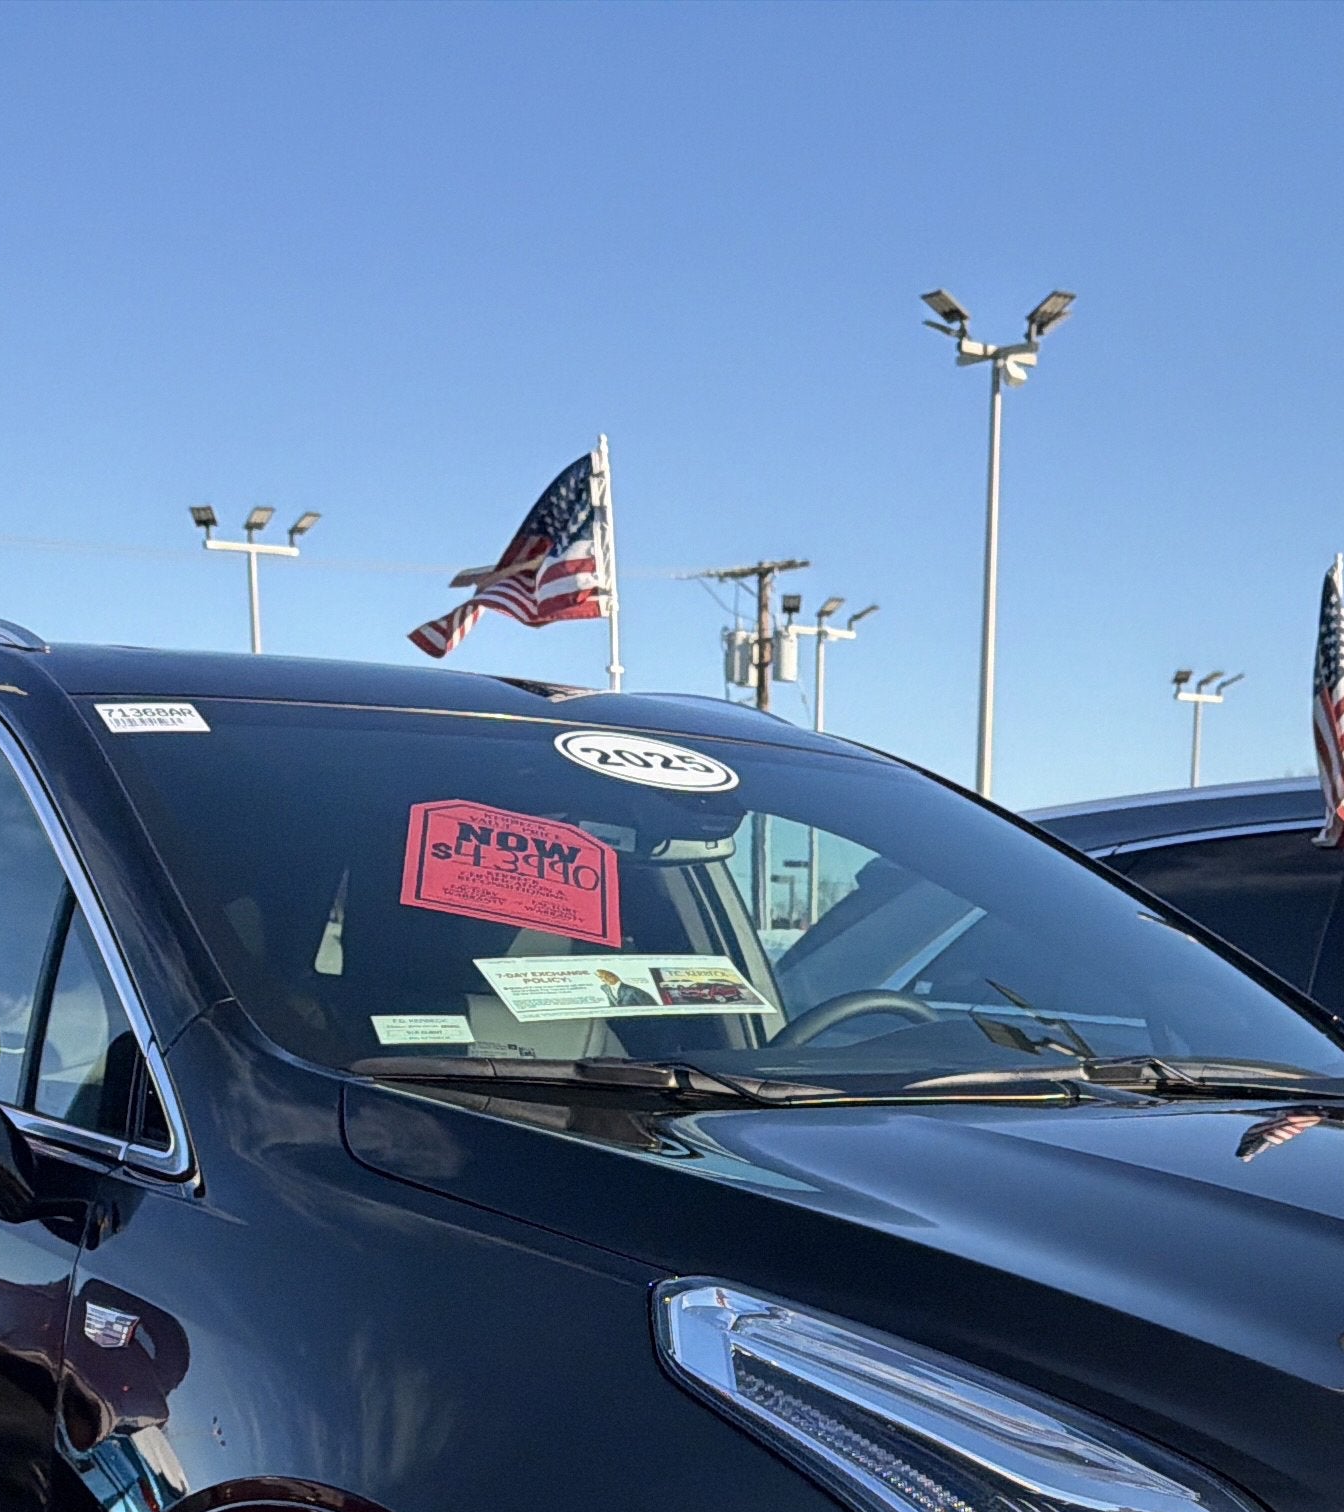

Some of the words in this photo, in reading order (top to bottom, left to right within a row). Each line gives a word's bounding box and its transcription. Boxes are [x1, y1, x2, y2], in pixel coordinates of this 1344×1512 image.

[102, 707, 196, 718] 71368AR
[579, 746, 715, 774] 2025
[457, 821, 582, 864] NOW
[495, 972, 528, 980] 7-DAY
